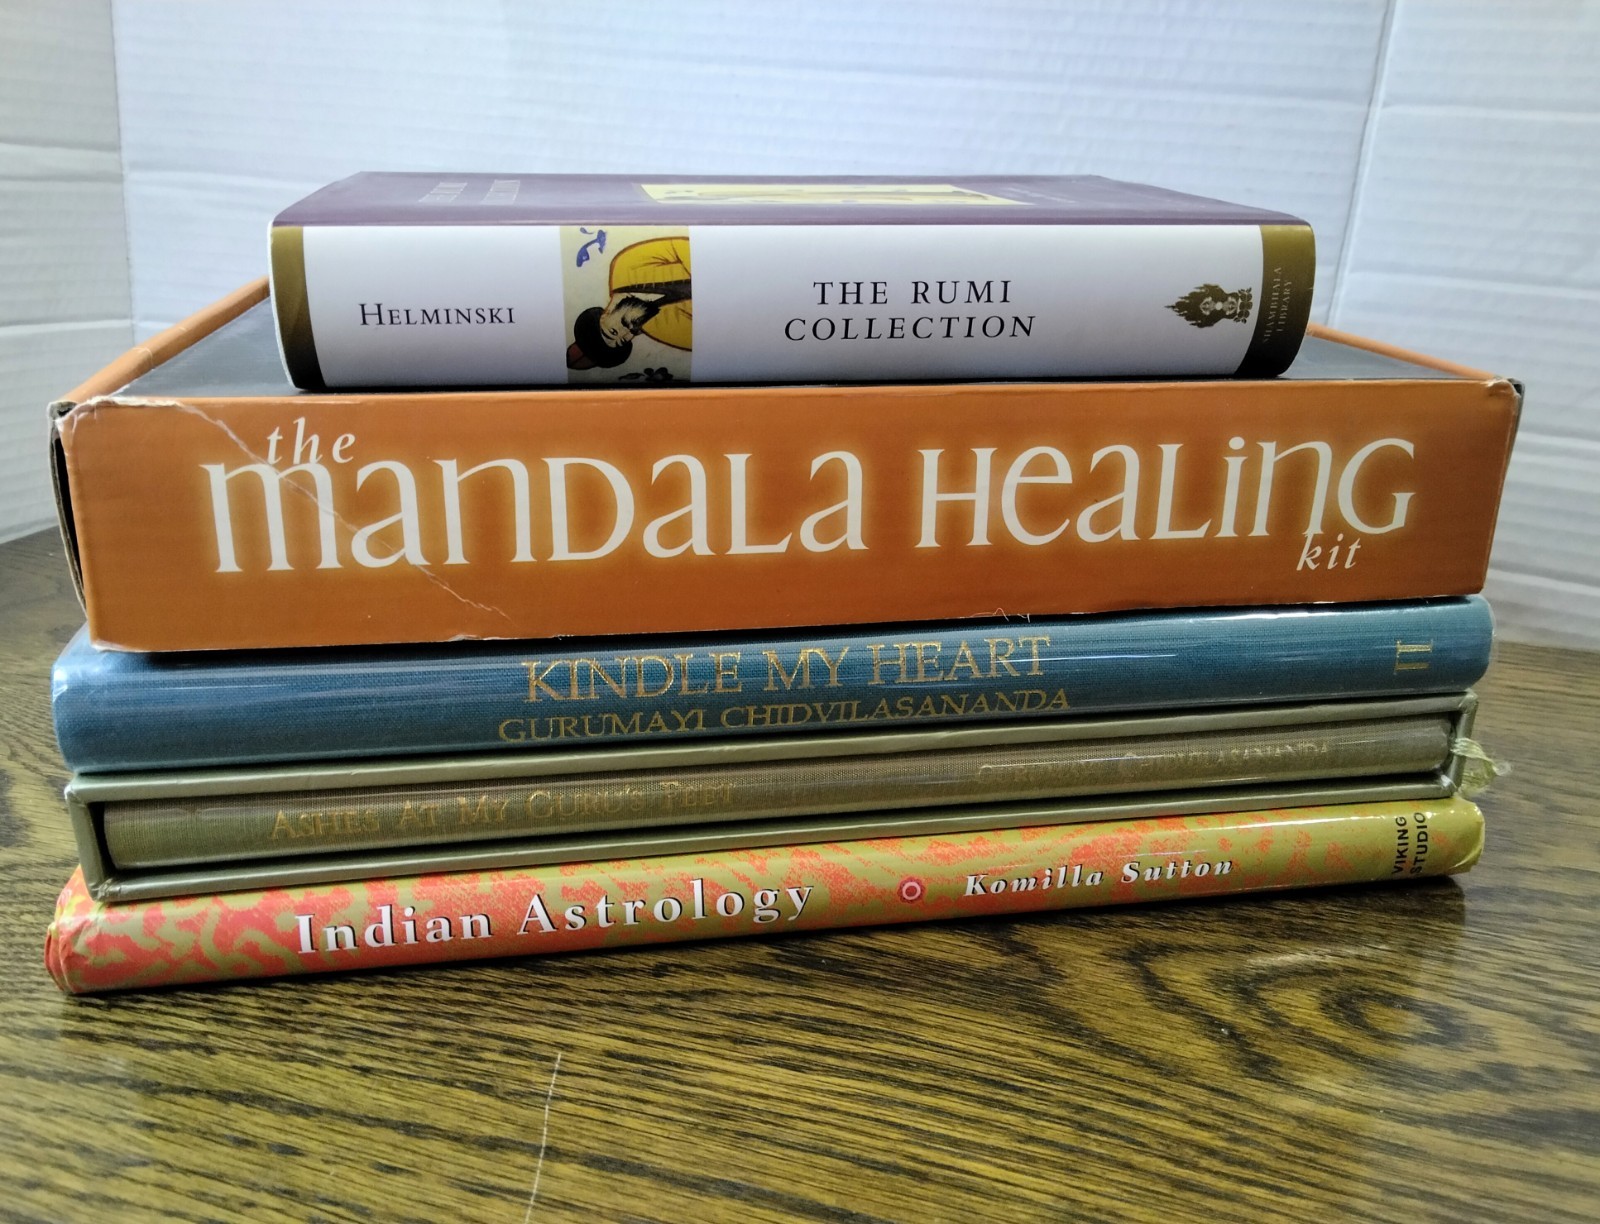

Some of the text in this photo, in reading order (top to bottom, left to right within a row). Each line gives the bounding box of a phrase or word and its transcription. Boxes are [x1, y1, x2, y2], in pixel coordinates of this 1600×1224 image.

[813, 280, 1012, 305] THE RUMI
[358, 303, 516, 326] HELMINSKI
[784, 315, 1036, 341] COLLECTION
[266, 417, 356, 464] the
[1296, 533, 1361, 571] kit
[521, 636, 1052, 703] KINDLE MY HEART
[498, 688, 1071, 743] GURUMAYI CHIDVILASANANDA
[400, 799, 441, 829] AT
[1392, 816, 1409, 875] VIKING
[1409, 812, 1428, 875] STUDIO
[964, 860, 1234, 898] Komilla Sutton
[294, 878, 814, 955] Indian Astrology
